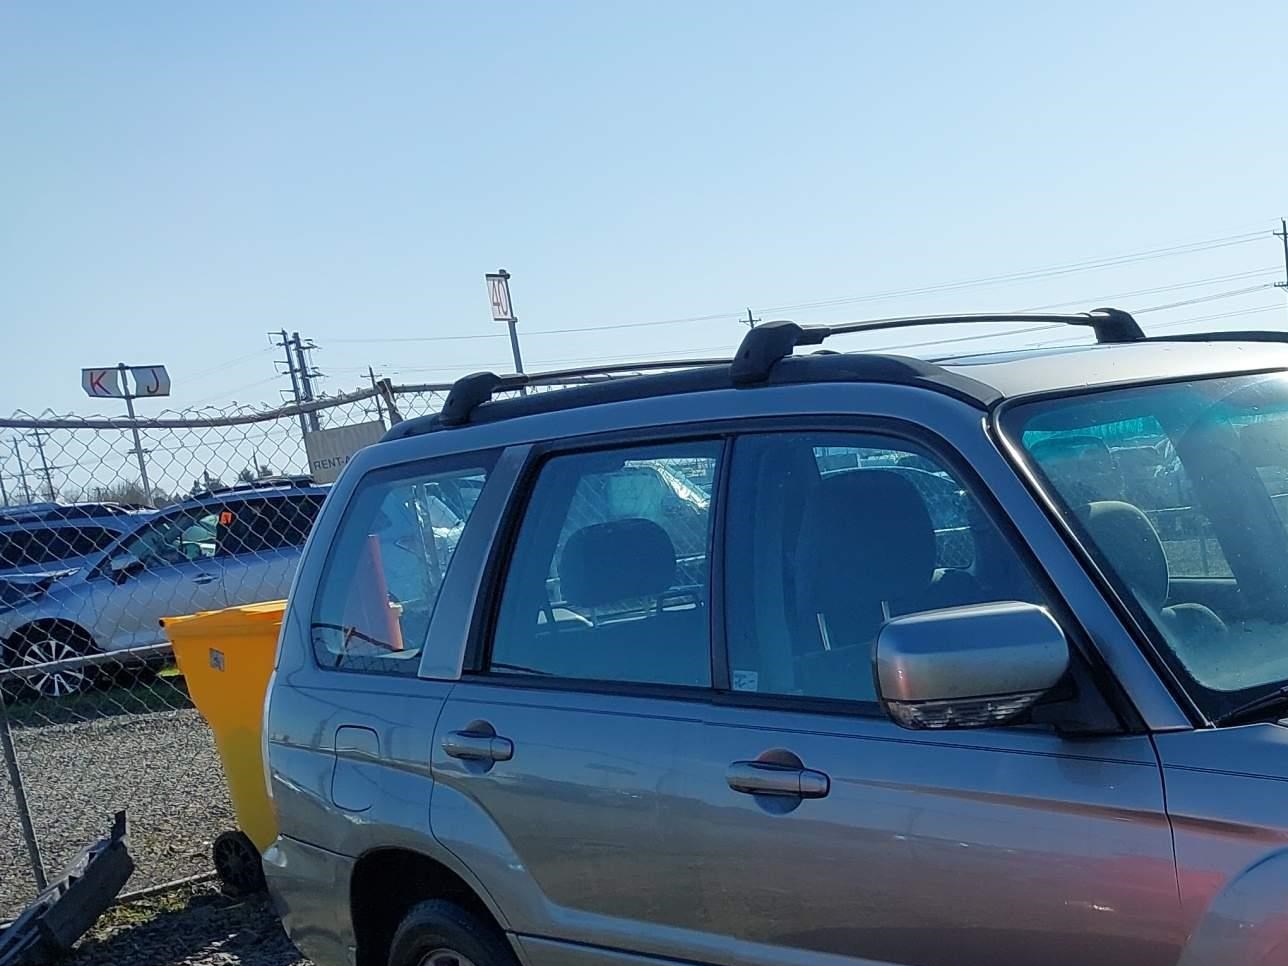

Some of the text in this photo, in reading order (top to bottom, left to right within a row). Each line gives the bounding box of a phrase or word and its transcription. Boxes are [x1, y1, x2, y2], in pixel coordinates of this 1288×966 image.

[492, 279, 508, 316] 40
[90, 371, 111, 394] K
[146, 369, 159, 393] J
